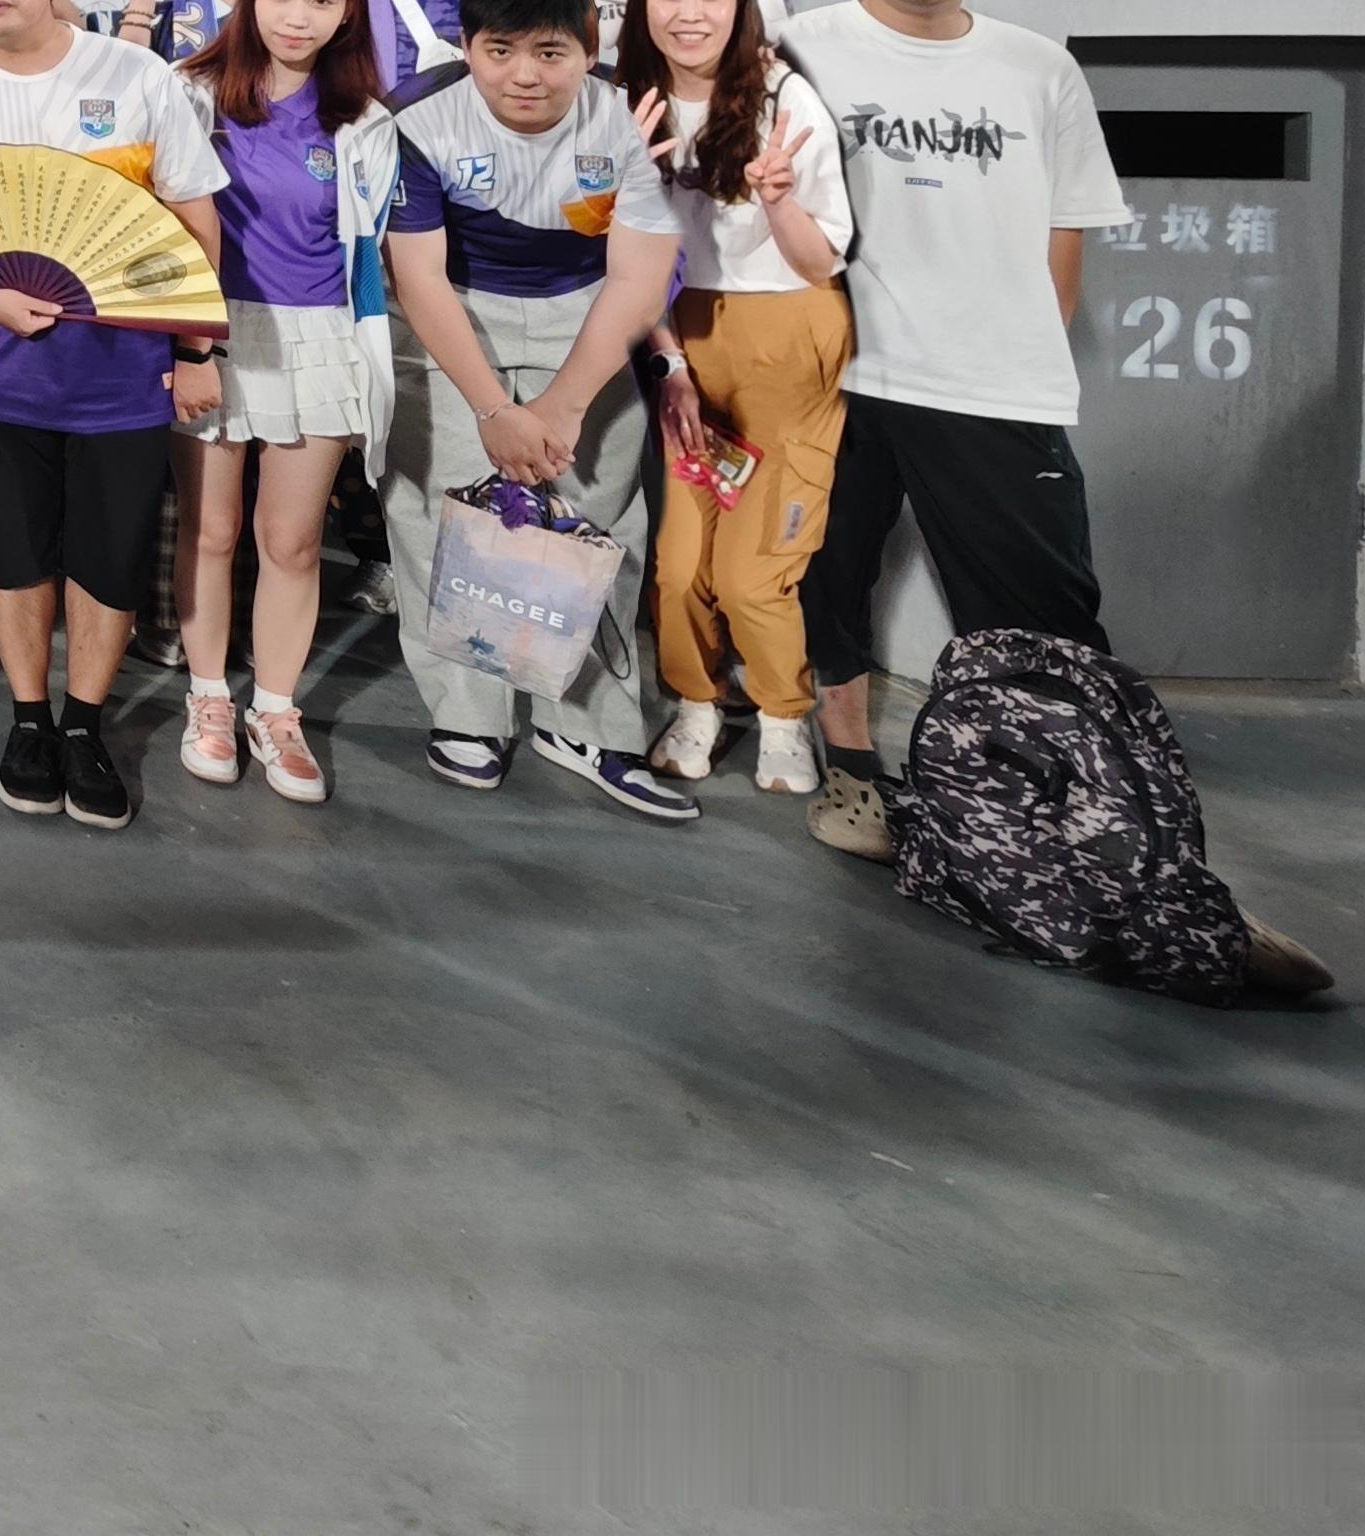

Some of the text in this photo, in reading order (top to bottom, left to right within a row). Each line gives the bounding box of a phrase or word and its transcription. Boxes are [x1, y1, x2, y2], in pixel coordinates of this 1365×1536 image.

[841, 113, 1003, 162] TIANJIN
[456, 152, 497, 192] 12
[1120, 295, 1253, 381] 26
[450, 577, 566, 629] CHAGEE
